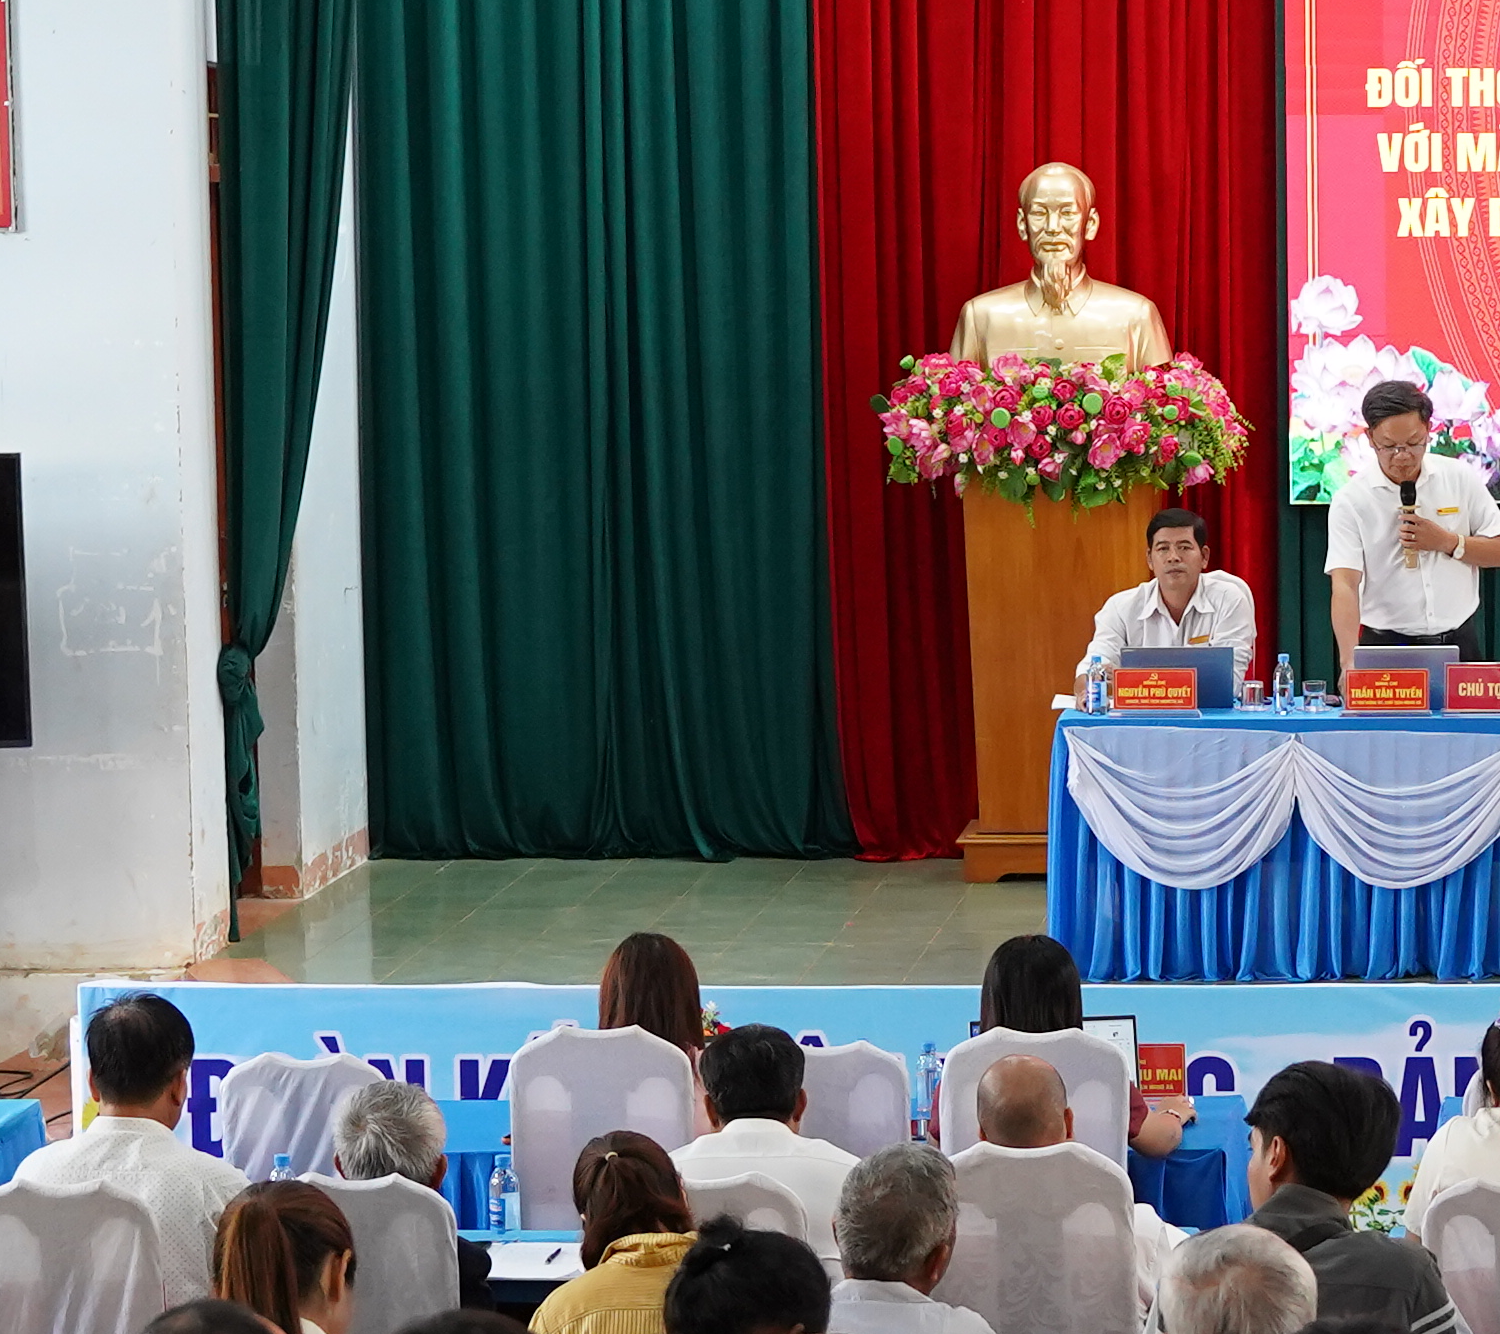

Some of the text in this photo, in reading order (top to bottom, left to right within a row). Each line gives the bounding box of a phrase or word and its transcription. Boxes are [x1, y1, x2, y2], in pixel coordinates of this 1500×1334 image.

[1366, 59, 1433, 108] ĐỐI
[1377, 123, 1442, 173] VỚI
[1397, 188, 1475, 237] XÂY
[1459, 678, 1484, 696] CHỦ
[1157, 1068, 1182, 1081] MAI
